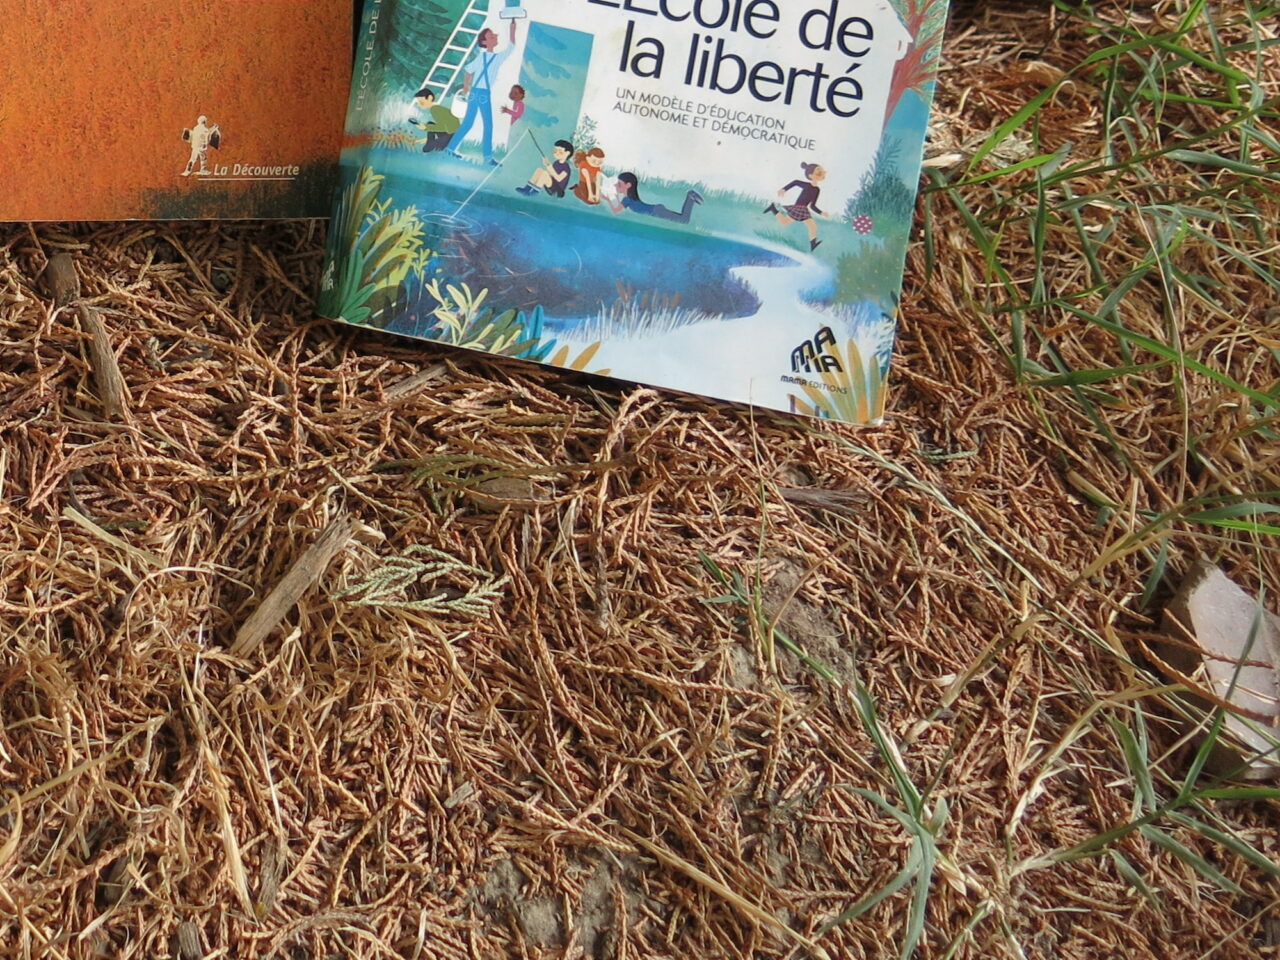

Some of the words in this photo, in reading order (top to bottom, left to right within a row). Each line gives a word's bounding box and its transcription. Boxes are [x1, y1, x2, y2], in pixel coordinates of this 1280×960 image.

[369, 9, 380, 34] DE
[798, 0, 874, 58] de
[619, 20, 665, 79] la
[684, 33, 863, 118] liberté
[613, 101, 689, 126] AUTONOME
[693, 116, 708, 129] ET
[712, 118, 816, 151] DÉMOCRATIQUE
[616, 88, 636, 101] UN
[639, 89, 694, 113] MODÈLE
[697, 102, 786, 130] D'ÉDUCATION
[213, 163, 227, 176] La
[233, 163, 300, 177] Découverte
